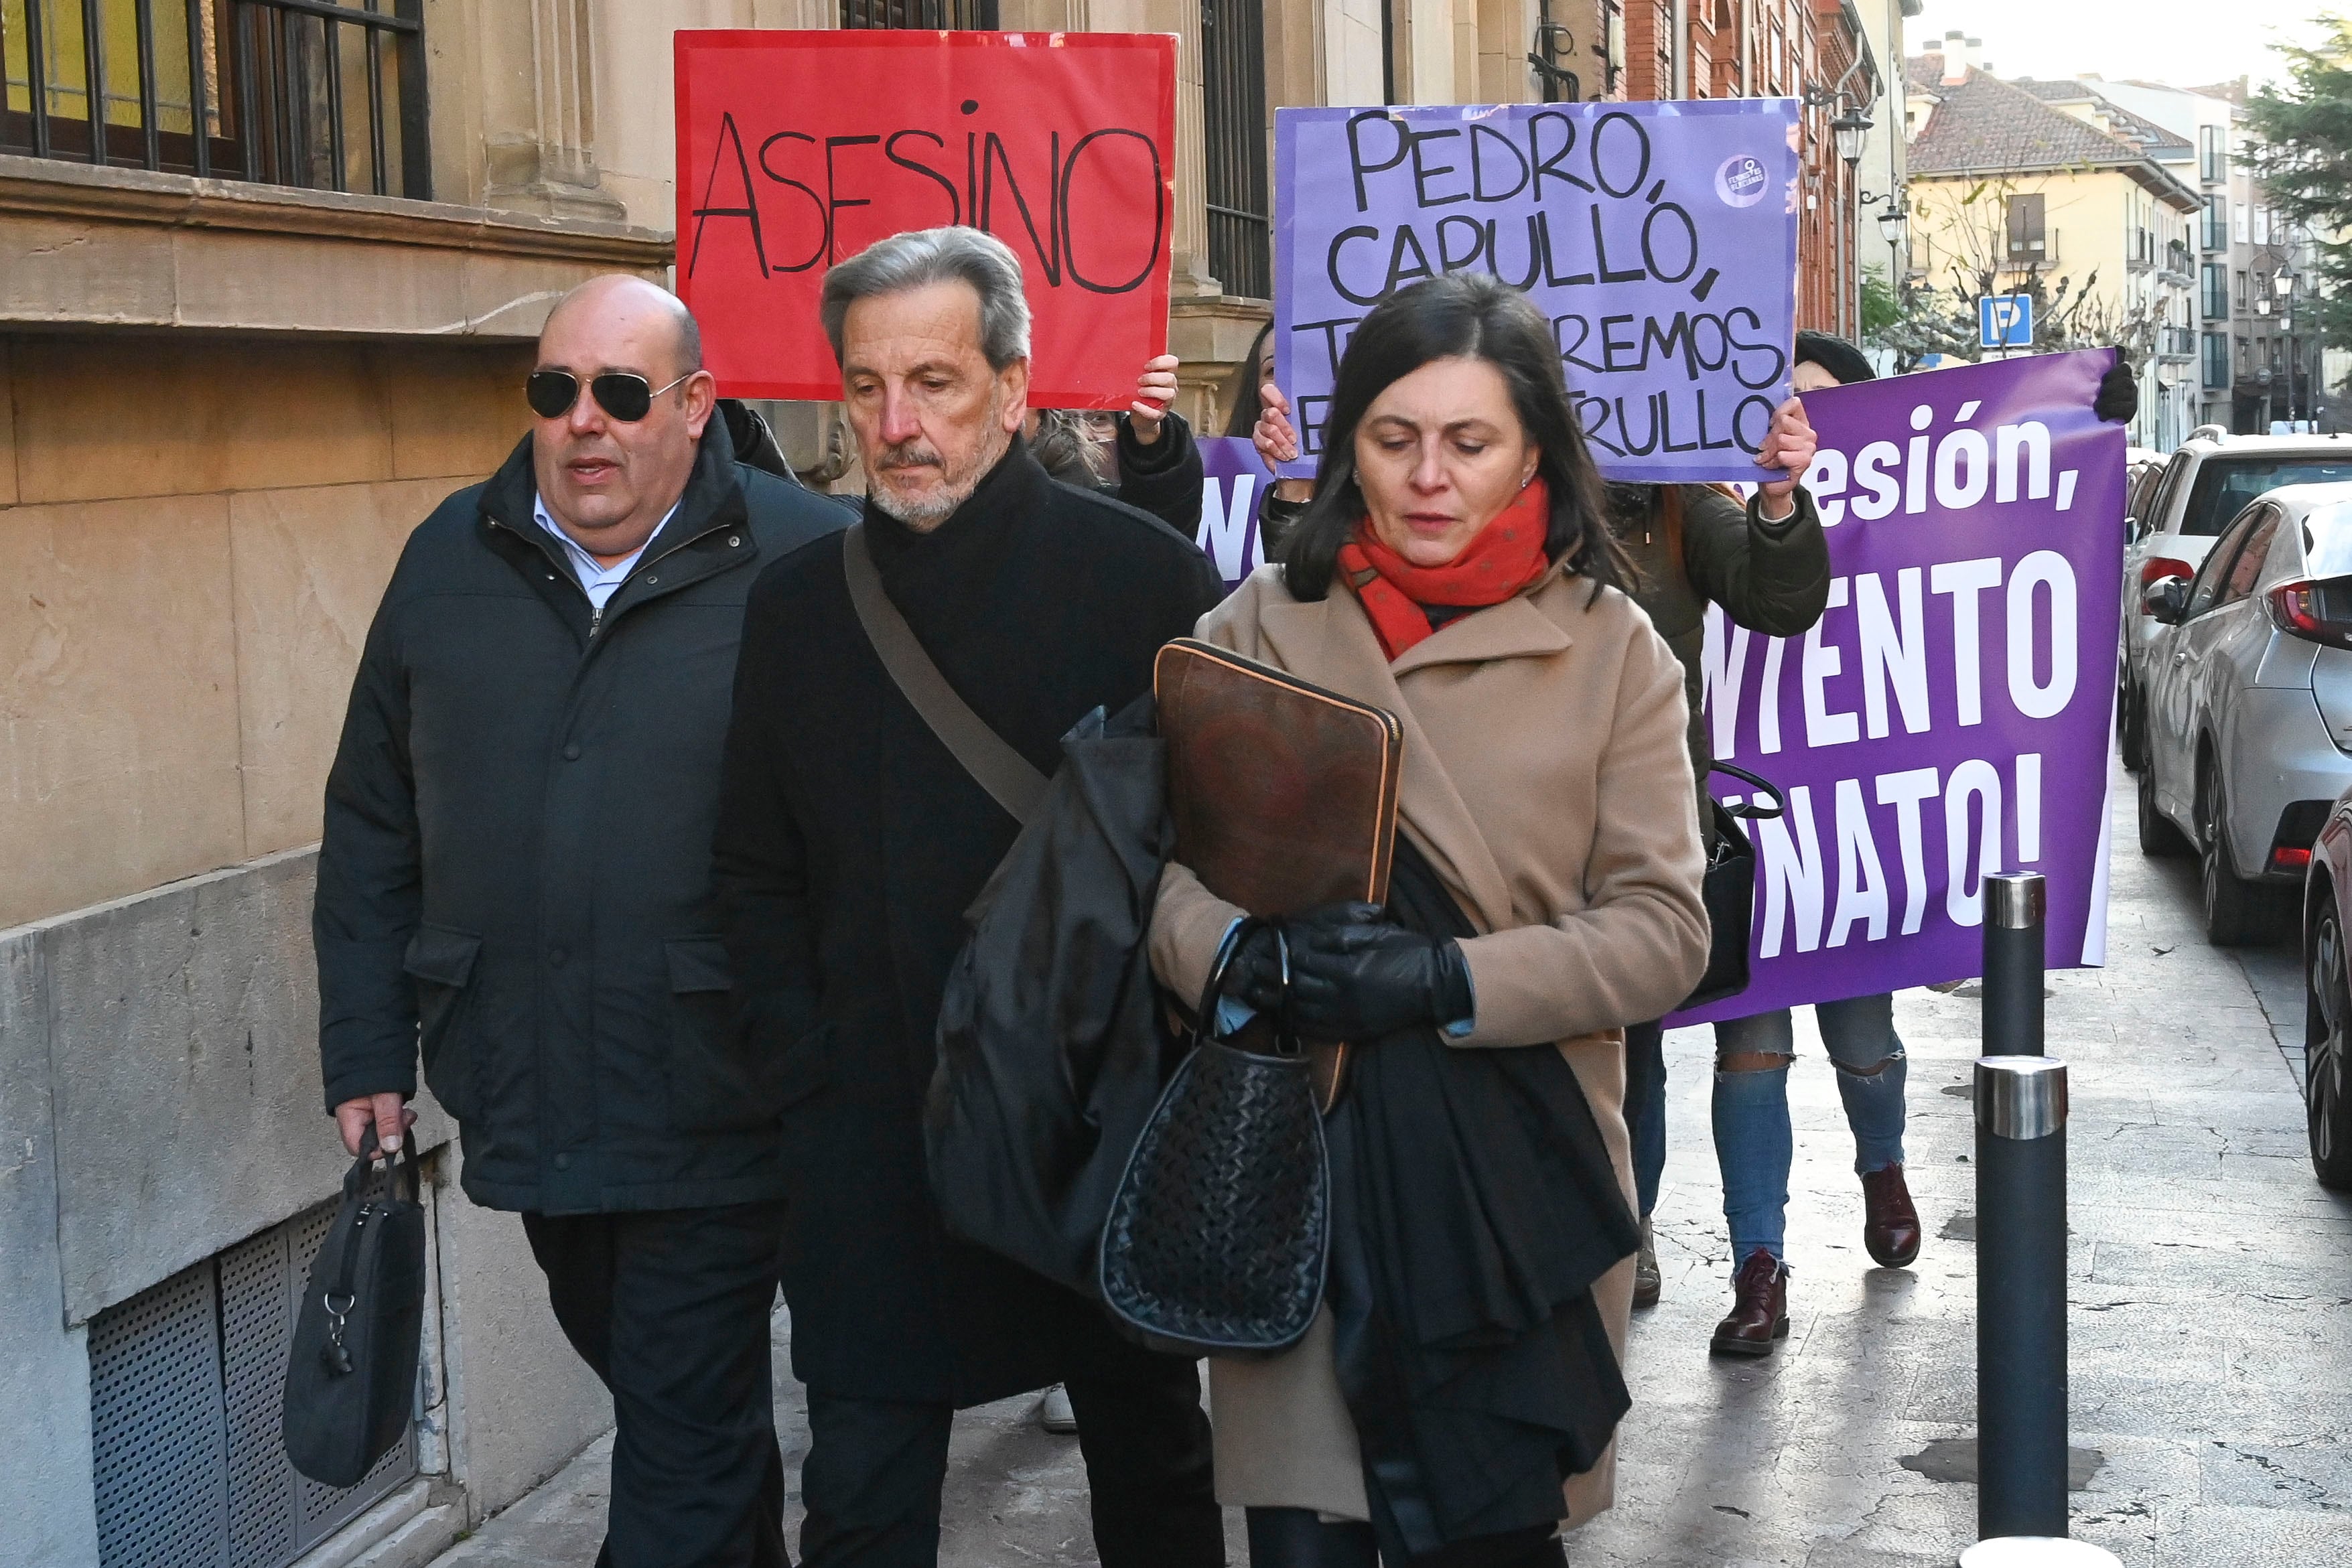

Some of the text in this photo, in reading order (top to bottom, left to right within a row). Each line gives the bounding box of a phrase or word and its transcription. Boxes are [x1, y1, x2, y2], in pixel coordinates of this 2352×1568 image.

[1346, 110, 1665, 212] PEDRO,
[1327, 202, 1720, 306] CAPULLO,
[1545, 307, 1785, 389] REMOS
[1990, 301, 2022, 341] P
[1566, 389, 1777, 457] RULLO
